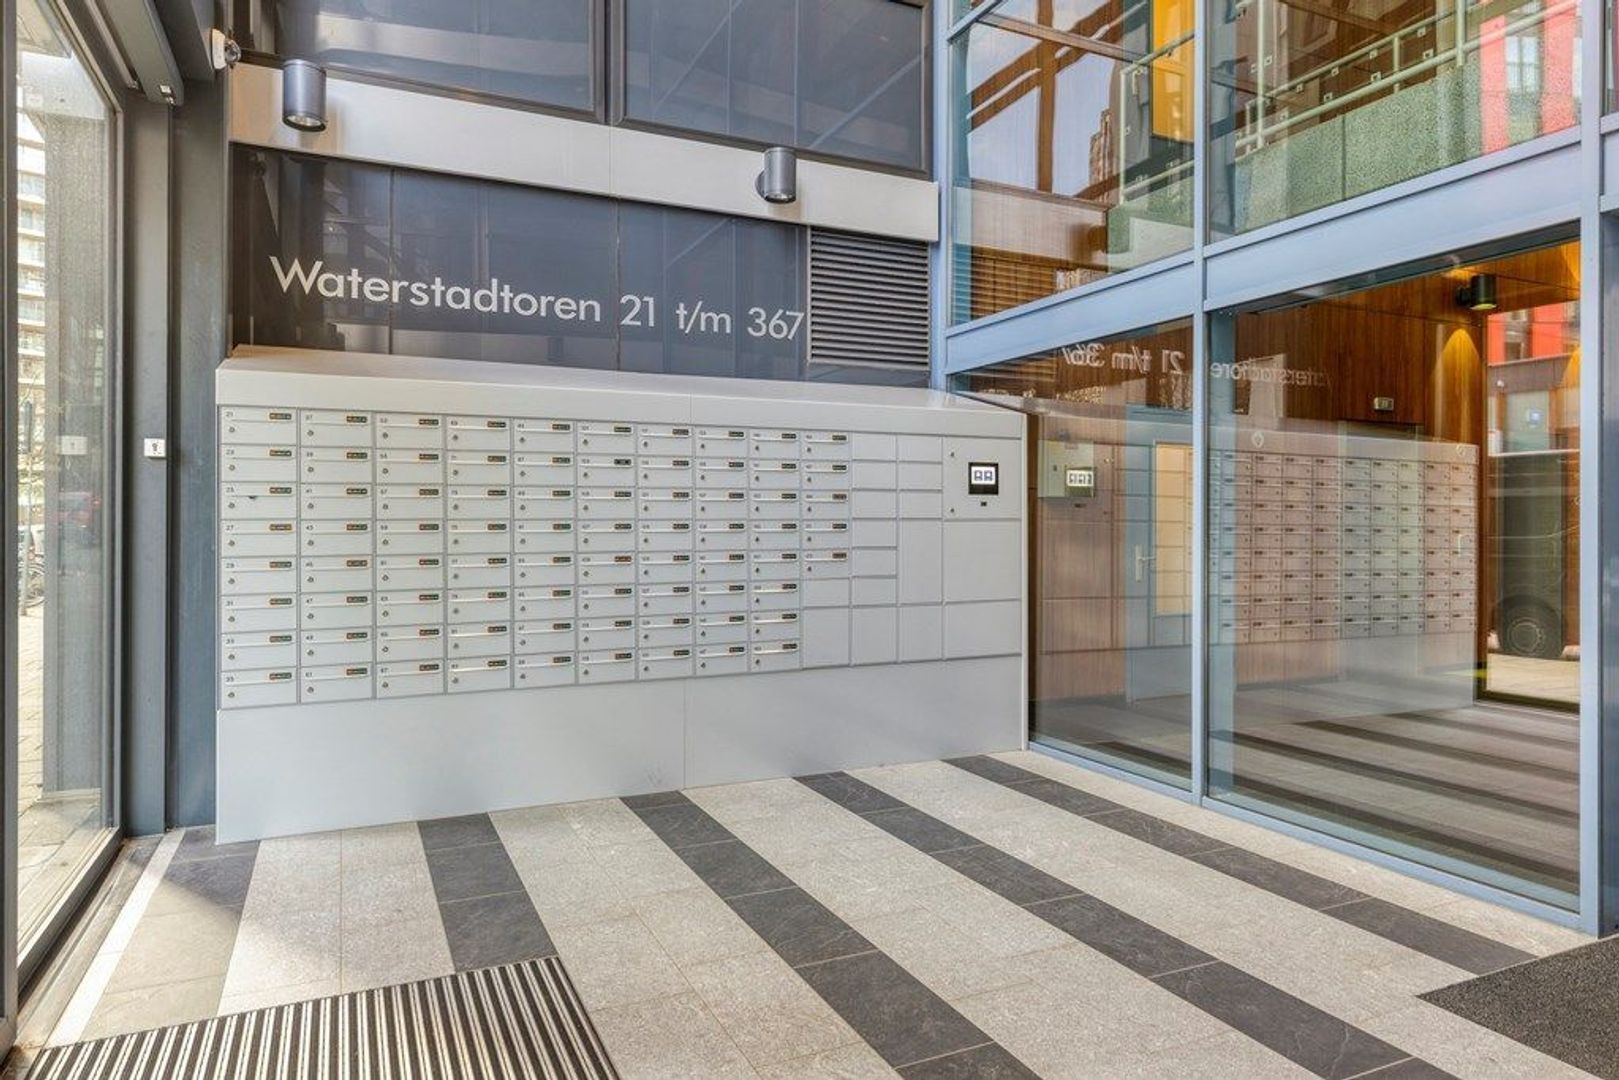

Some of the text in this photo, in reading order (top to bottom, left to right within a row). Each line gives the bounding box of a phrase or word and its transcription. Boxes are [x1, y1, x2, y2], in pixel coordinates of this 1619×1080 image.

[269, 255, 805, 340] Waterstadtoren 21 t/m 367
